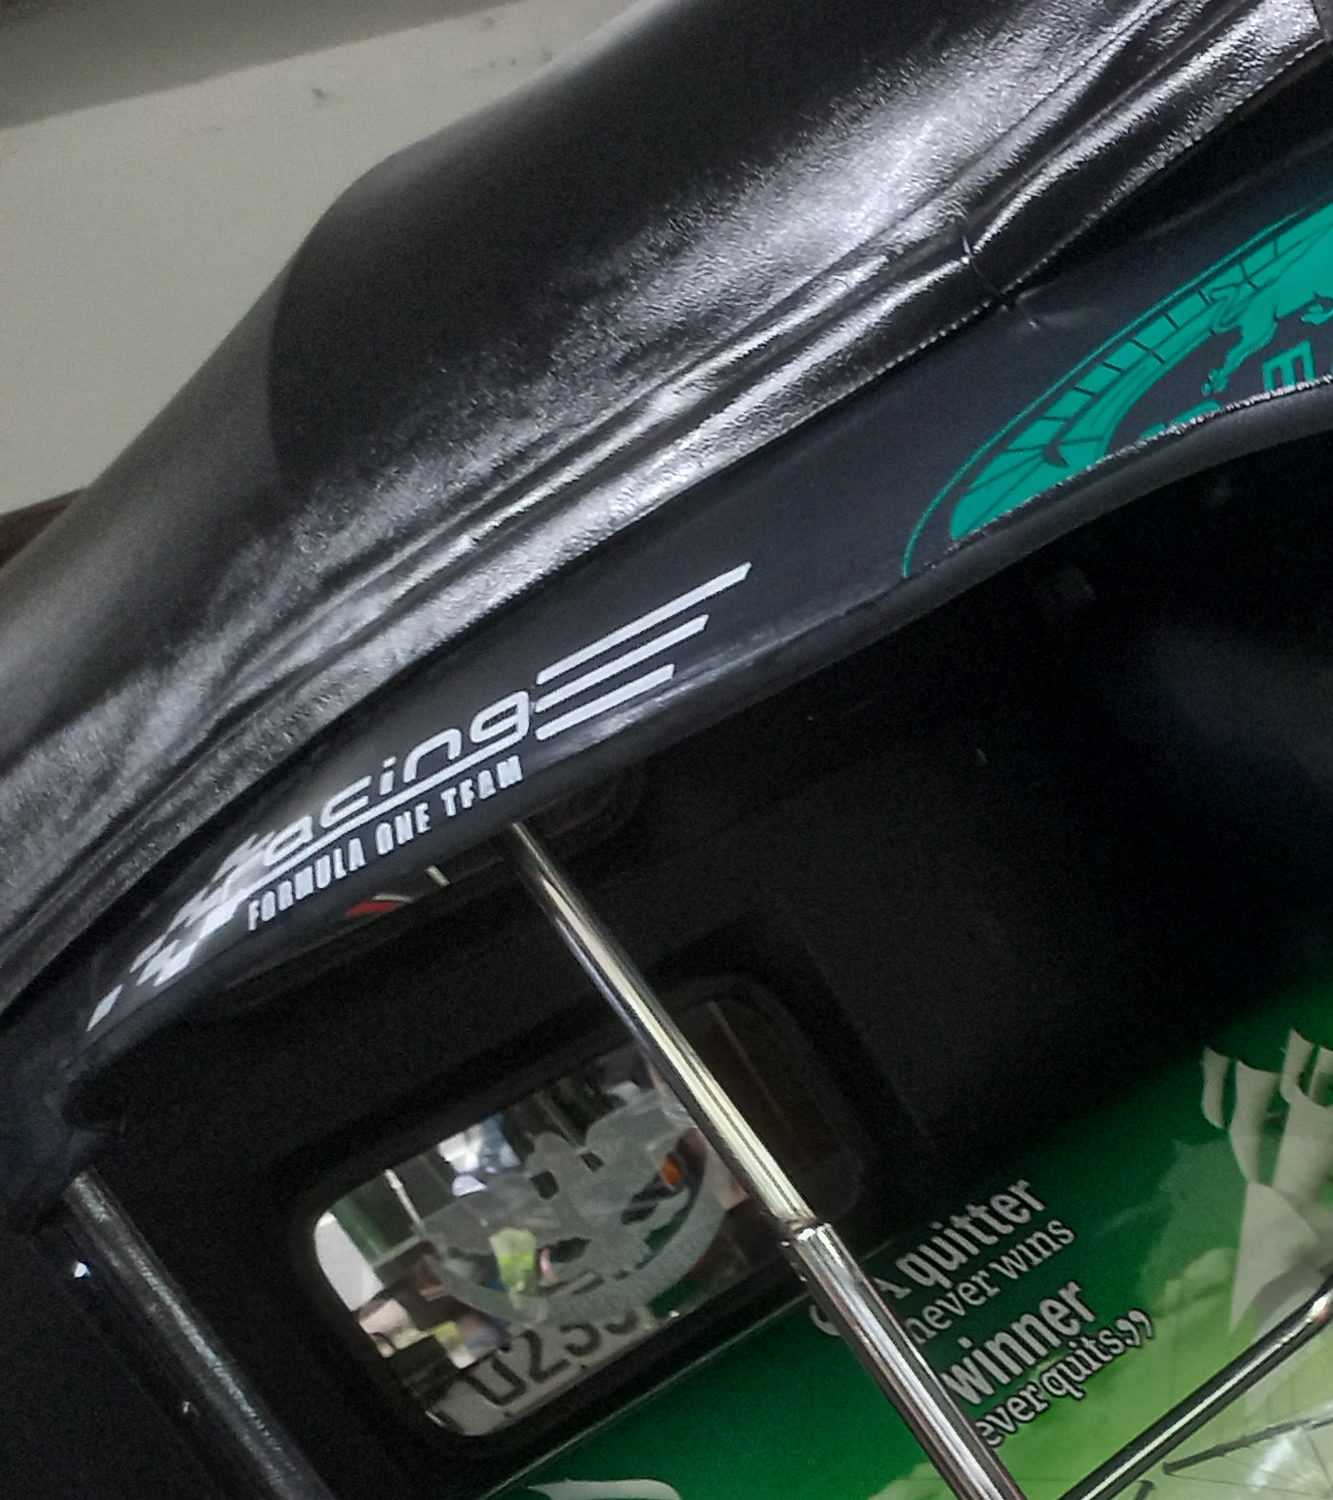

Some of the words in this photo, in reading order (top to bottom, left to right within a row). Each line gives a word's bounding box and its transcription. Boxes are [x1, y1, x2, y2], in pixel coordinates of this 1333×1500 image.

[249, 837, 366, 931] FORMULA
[374, 802, 431, 856] ONE
[439, 755, 523, 817] TEAM
[896, 1179, 1046, 1290] quitter
[1000, 1218, 1077, 1281] wins
[941, 1281, 1096, 1405] winner
[975, 1382, 1049, 1447] ever
